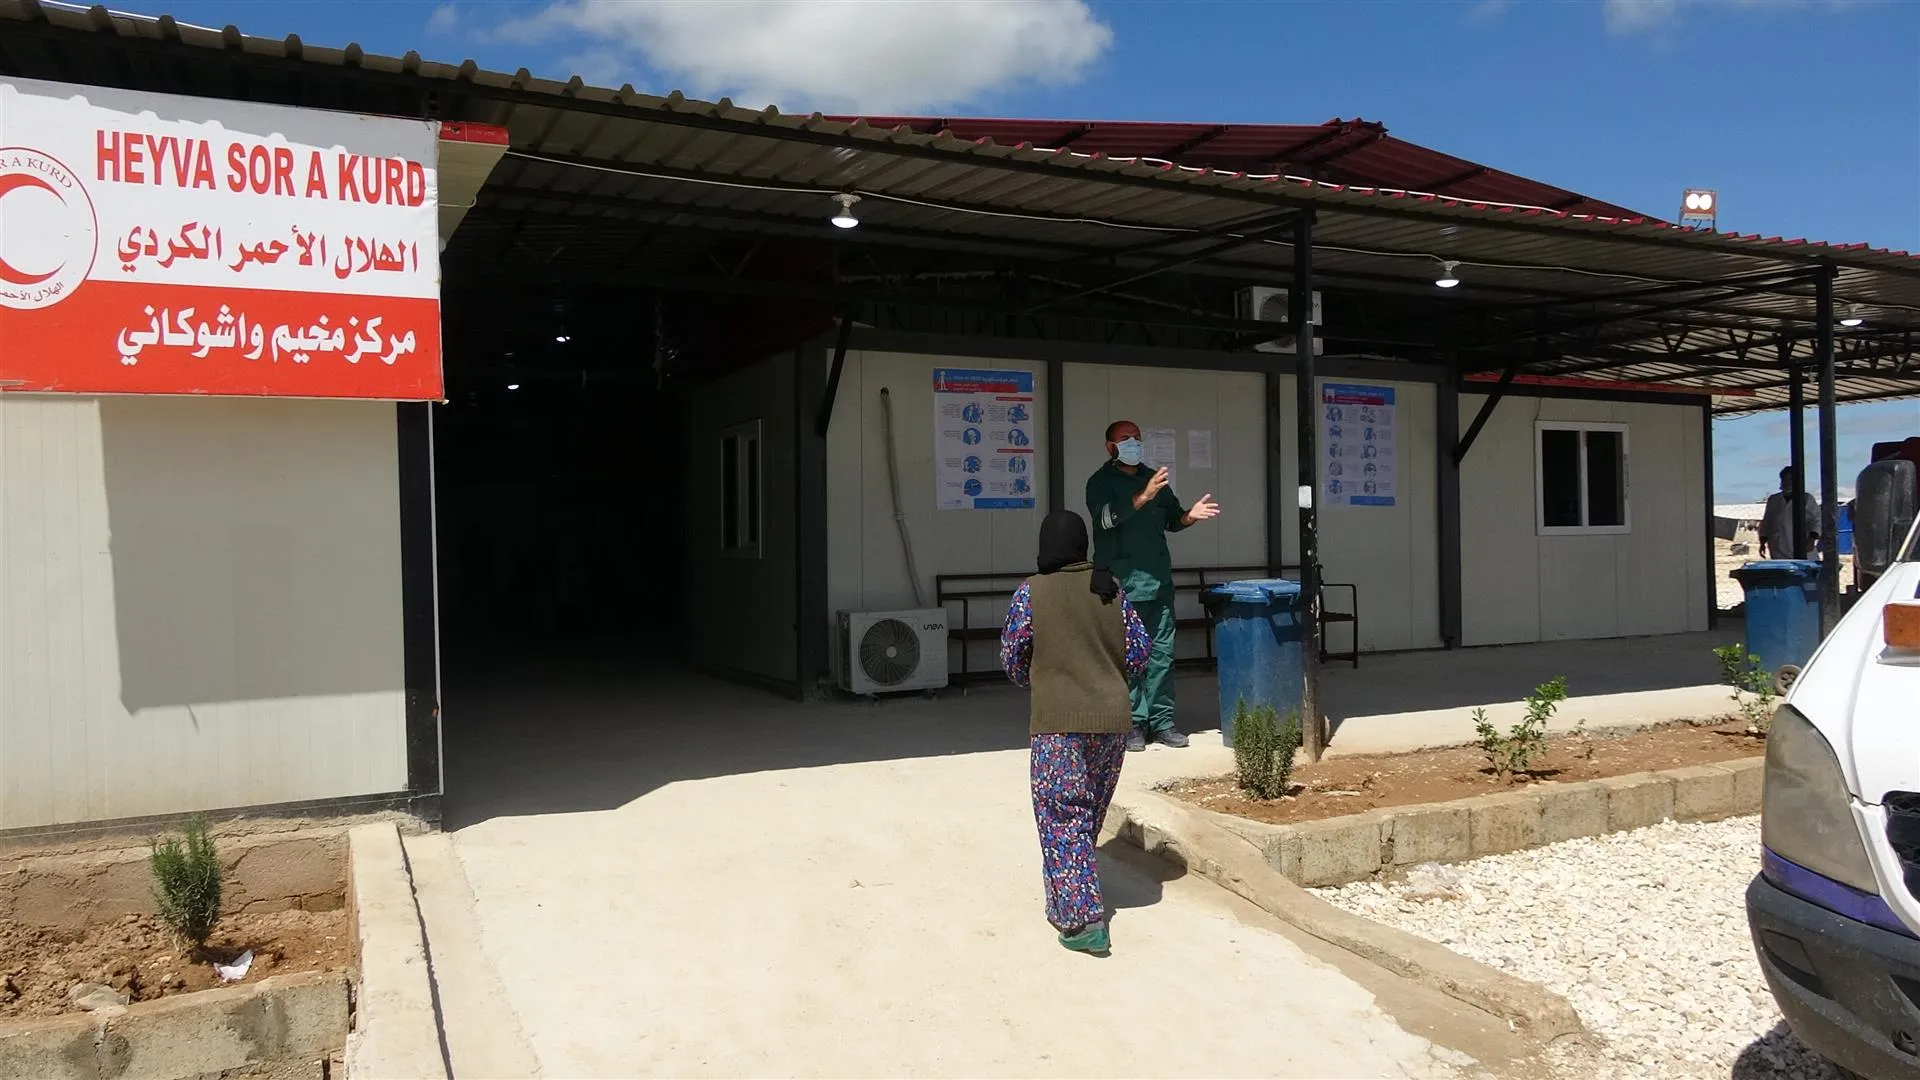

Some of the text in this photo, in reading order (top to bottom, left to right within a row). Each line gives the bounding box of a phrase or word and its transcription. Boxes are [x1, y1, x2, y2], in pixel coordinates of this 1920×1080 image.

[27, 157, 72, 188] KURD
[96, 130, 426, 208] HEYVA SOR A KURD
[117, 222, 418, 280] الهلال الأحمر الكردي
[34, 281, 64, 302] الهلال
[117, 303, 417, 366] مركز مخيم واشوكاني
